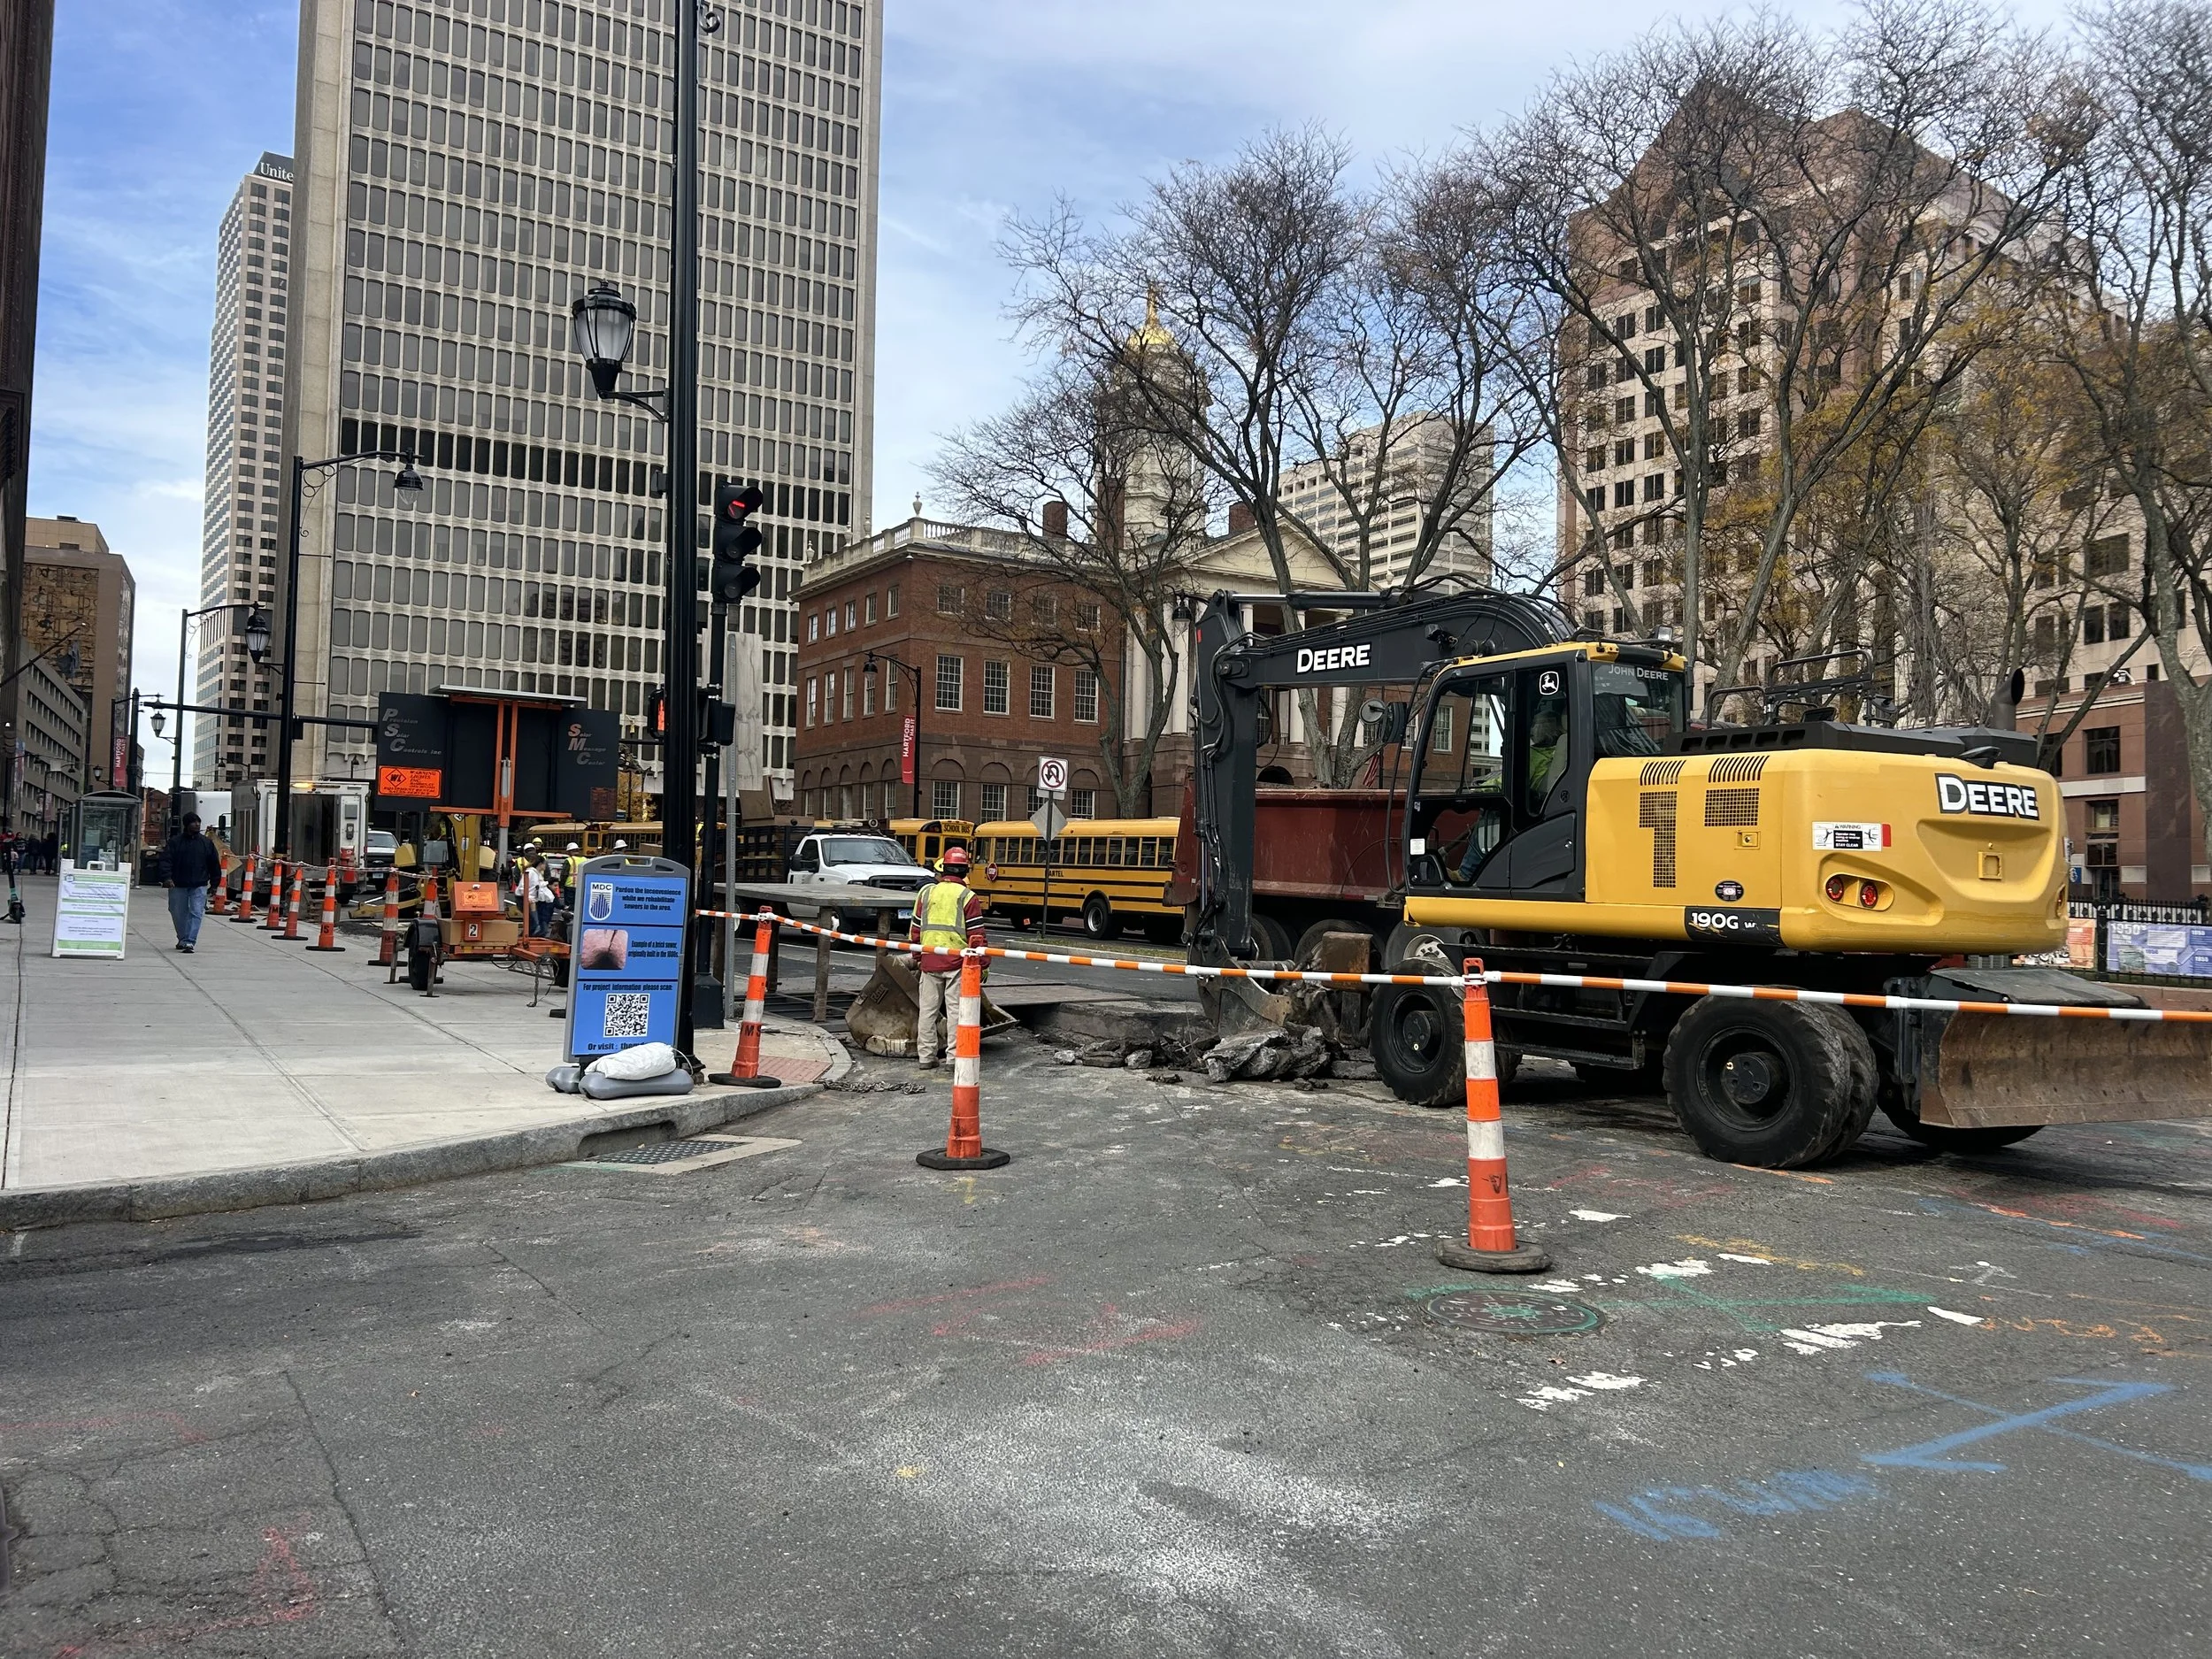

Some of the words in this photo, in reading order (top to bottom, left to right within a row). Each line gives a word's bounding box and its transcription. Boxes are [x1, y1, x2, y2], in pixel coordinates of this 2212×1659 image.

[1297, 644, 1371, 673] DEERE
[1609, 664, 1635, 677] JOHN
[1637, 667, 1669, 680] DEERE
[1937, 776, 2039, 818] DEERE
[943, 824, 960, 833] SCHOOL
[961, 825, 971, 833] BUS
[1691, 912, 1740, 930] 190G
[469, 924, 477, 937] 2
[592, 983, 611, 992] project
[588, 1042, 595, 1051] Or
